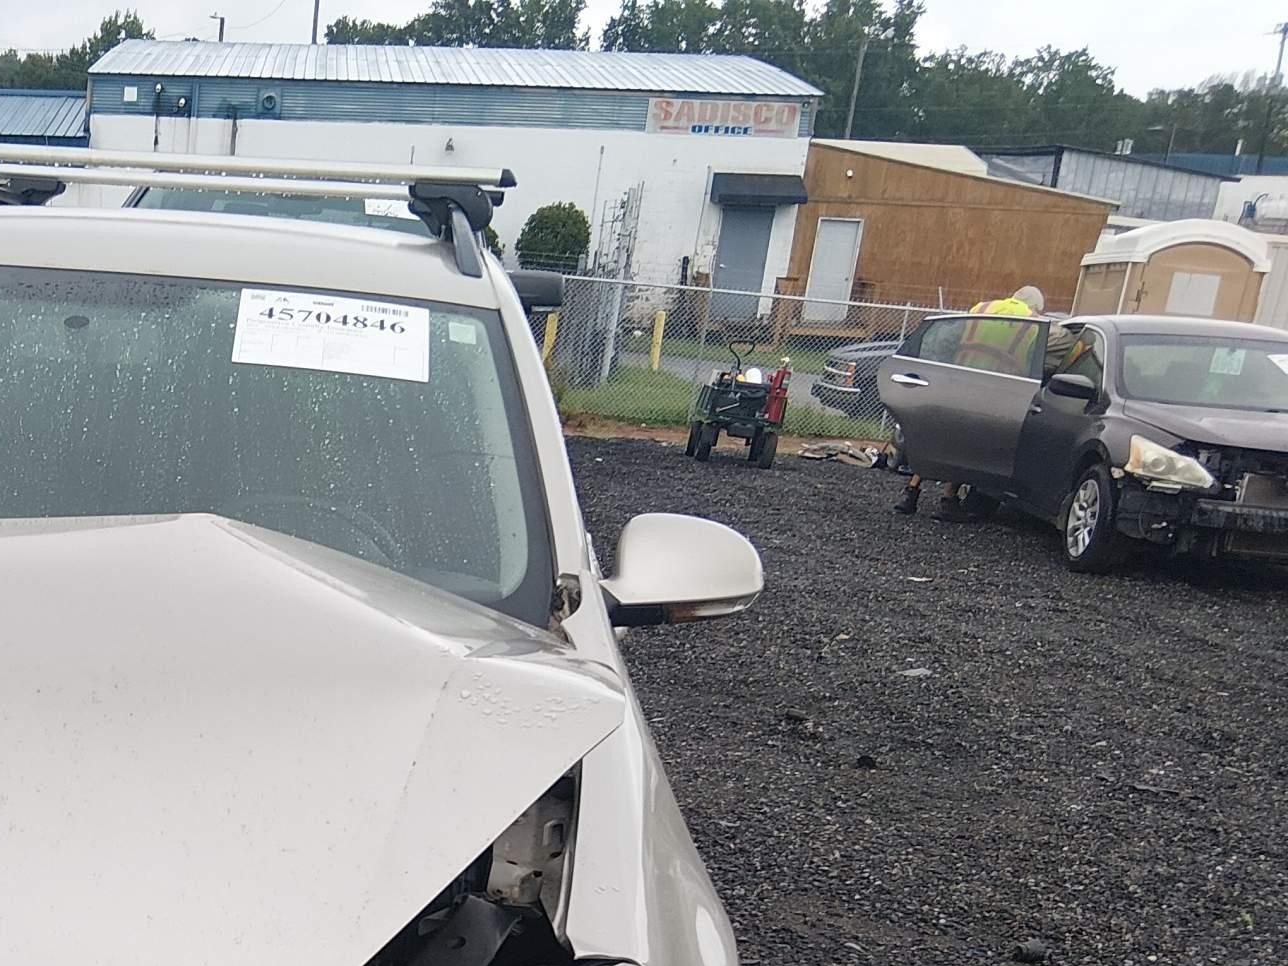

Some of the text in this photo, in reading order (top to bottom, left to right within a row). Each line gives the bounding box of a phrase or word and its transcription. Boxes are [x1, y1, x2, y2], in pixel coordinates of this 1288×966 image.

[653, 100, 798, 126] SADISCO
[690, 124, 754, 136] OFFICE
[258, 306, 407, 334] 45704846
